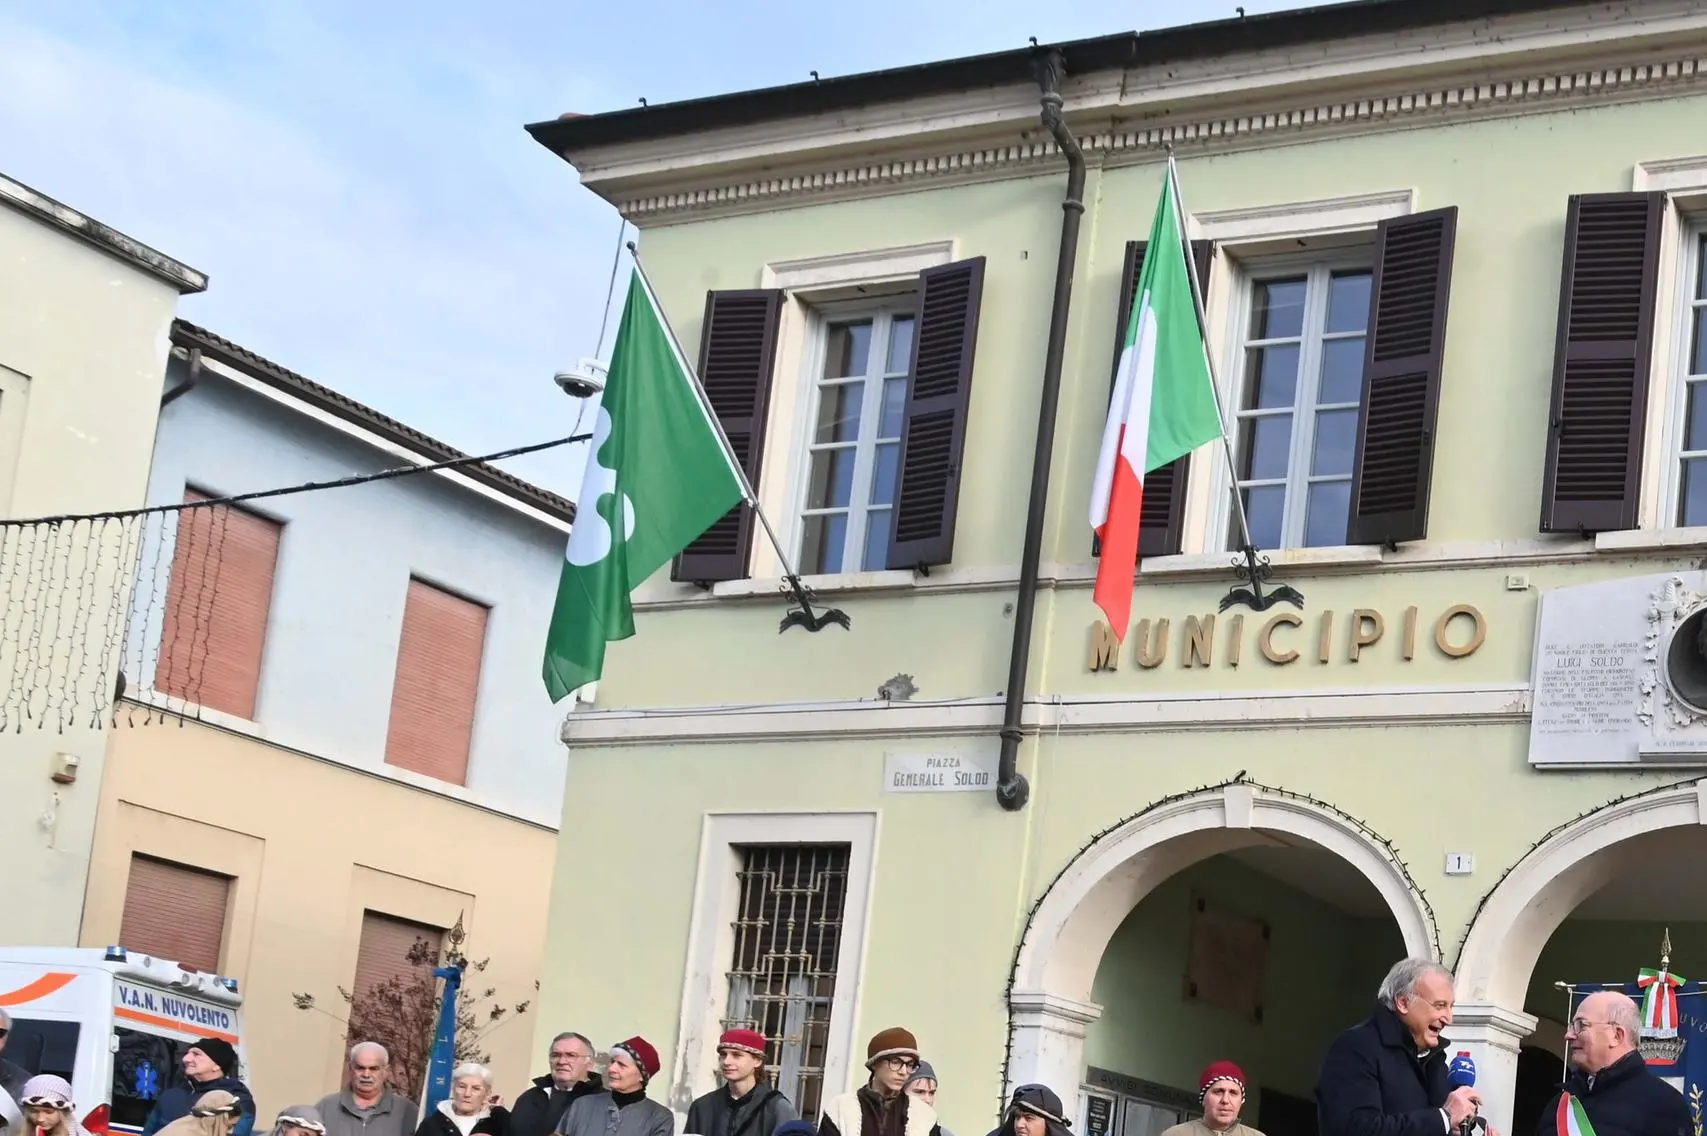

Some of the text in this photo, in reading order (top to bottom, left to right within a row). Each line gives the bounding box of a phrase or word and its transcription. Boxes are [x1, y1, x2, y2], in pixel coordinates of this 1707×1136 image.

[1088, 604, 1487, 671] MUNICIPIO
[926, 758, 961, 768] PIAZZA
[893, 771, 945, 786] GENERALE
[1456, 855, 1461, 870] 1
[118, 986, 229, 1029] V.A.N. NUVOLENTO
